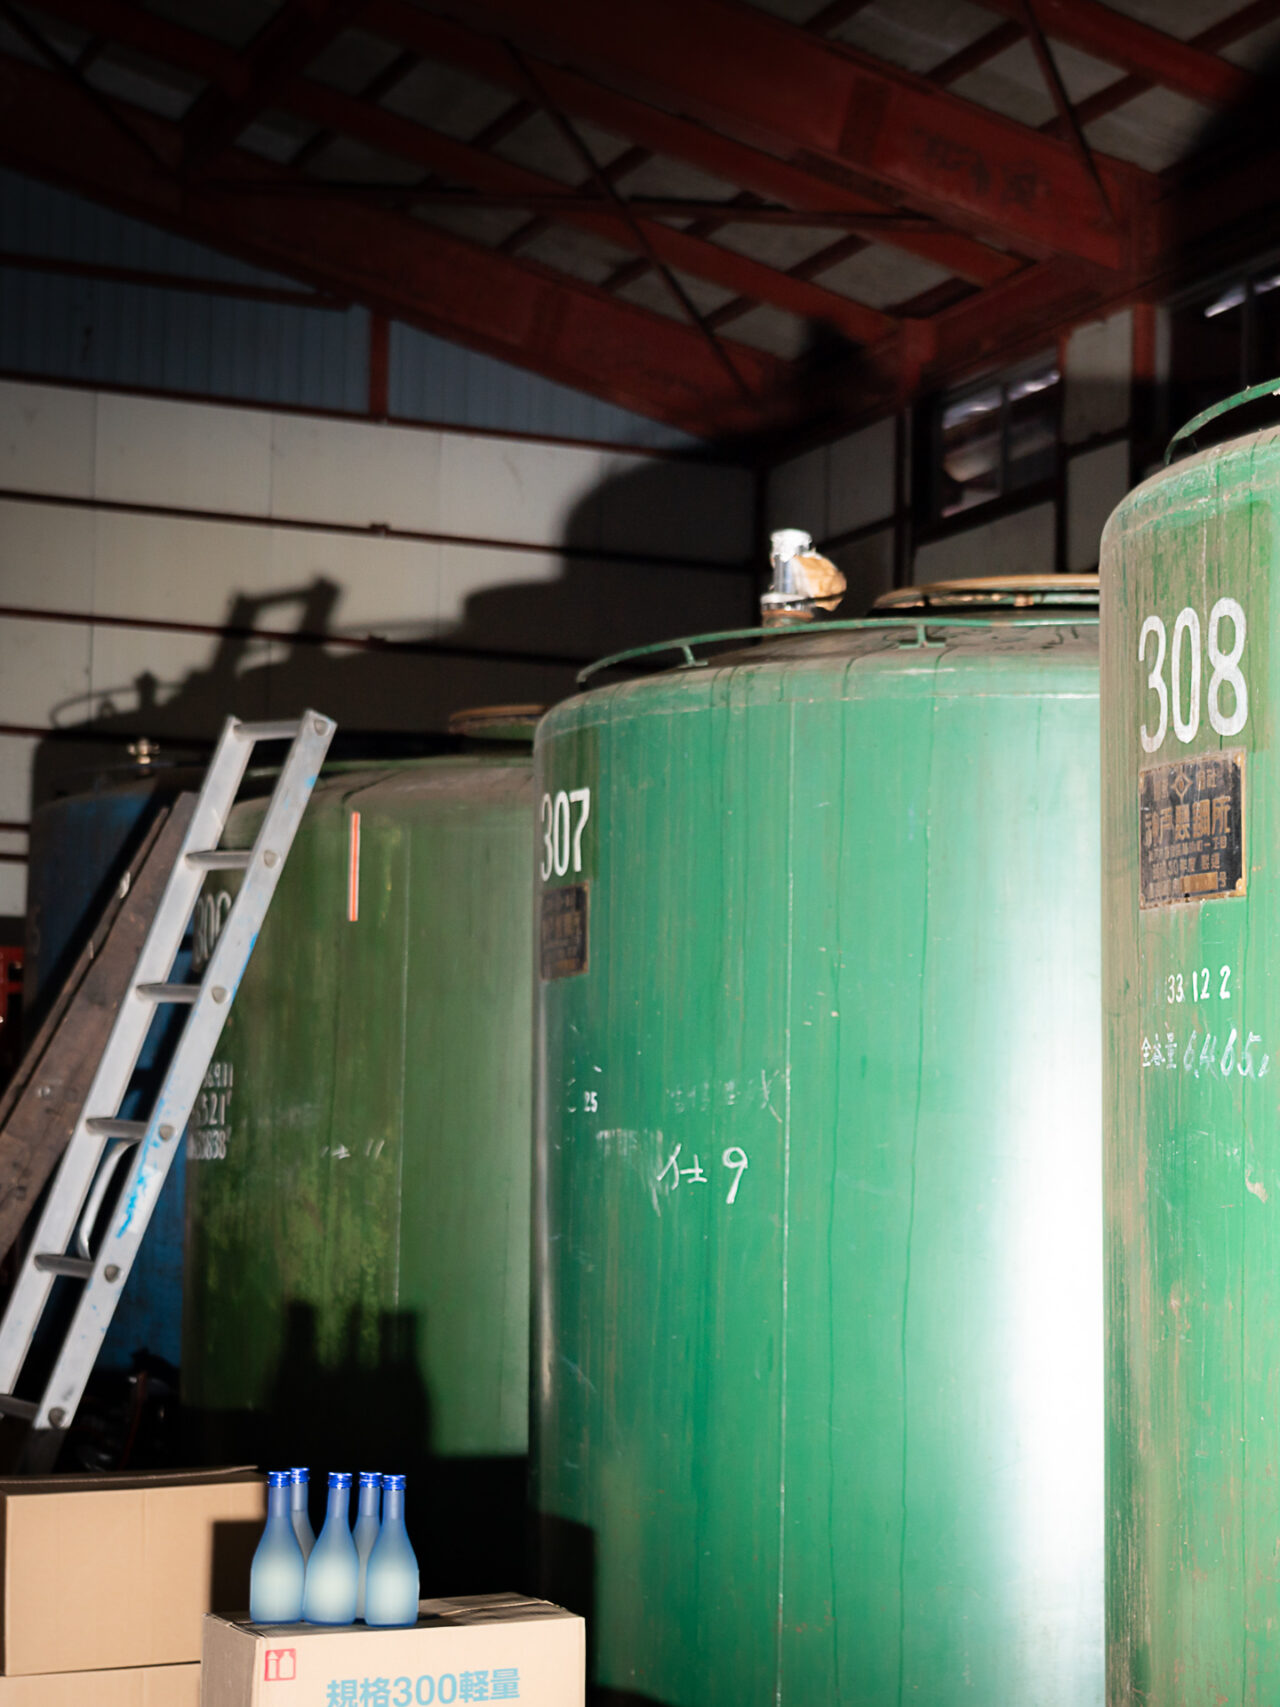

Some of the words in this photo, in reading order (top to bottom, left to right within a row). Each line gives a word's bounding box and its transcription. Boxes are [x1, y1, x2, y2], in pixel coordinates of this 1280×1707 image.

[1138, 598, 1248, 752] 308
[541, 788, 590, 881] 307
[1167, 974, 1185, 1004] 33
[1192, 967, 1210, 1003] 12
[1219, 964, 1231, 1000] 2
[722, 1146, 748, 1205] 9
[325, 1667, 521, 1707] 規格300軽量
